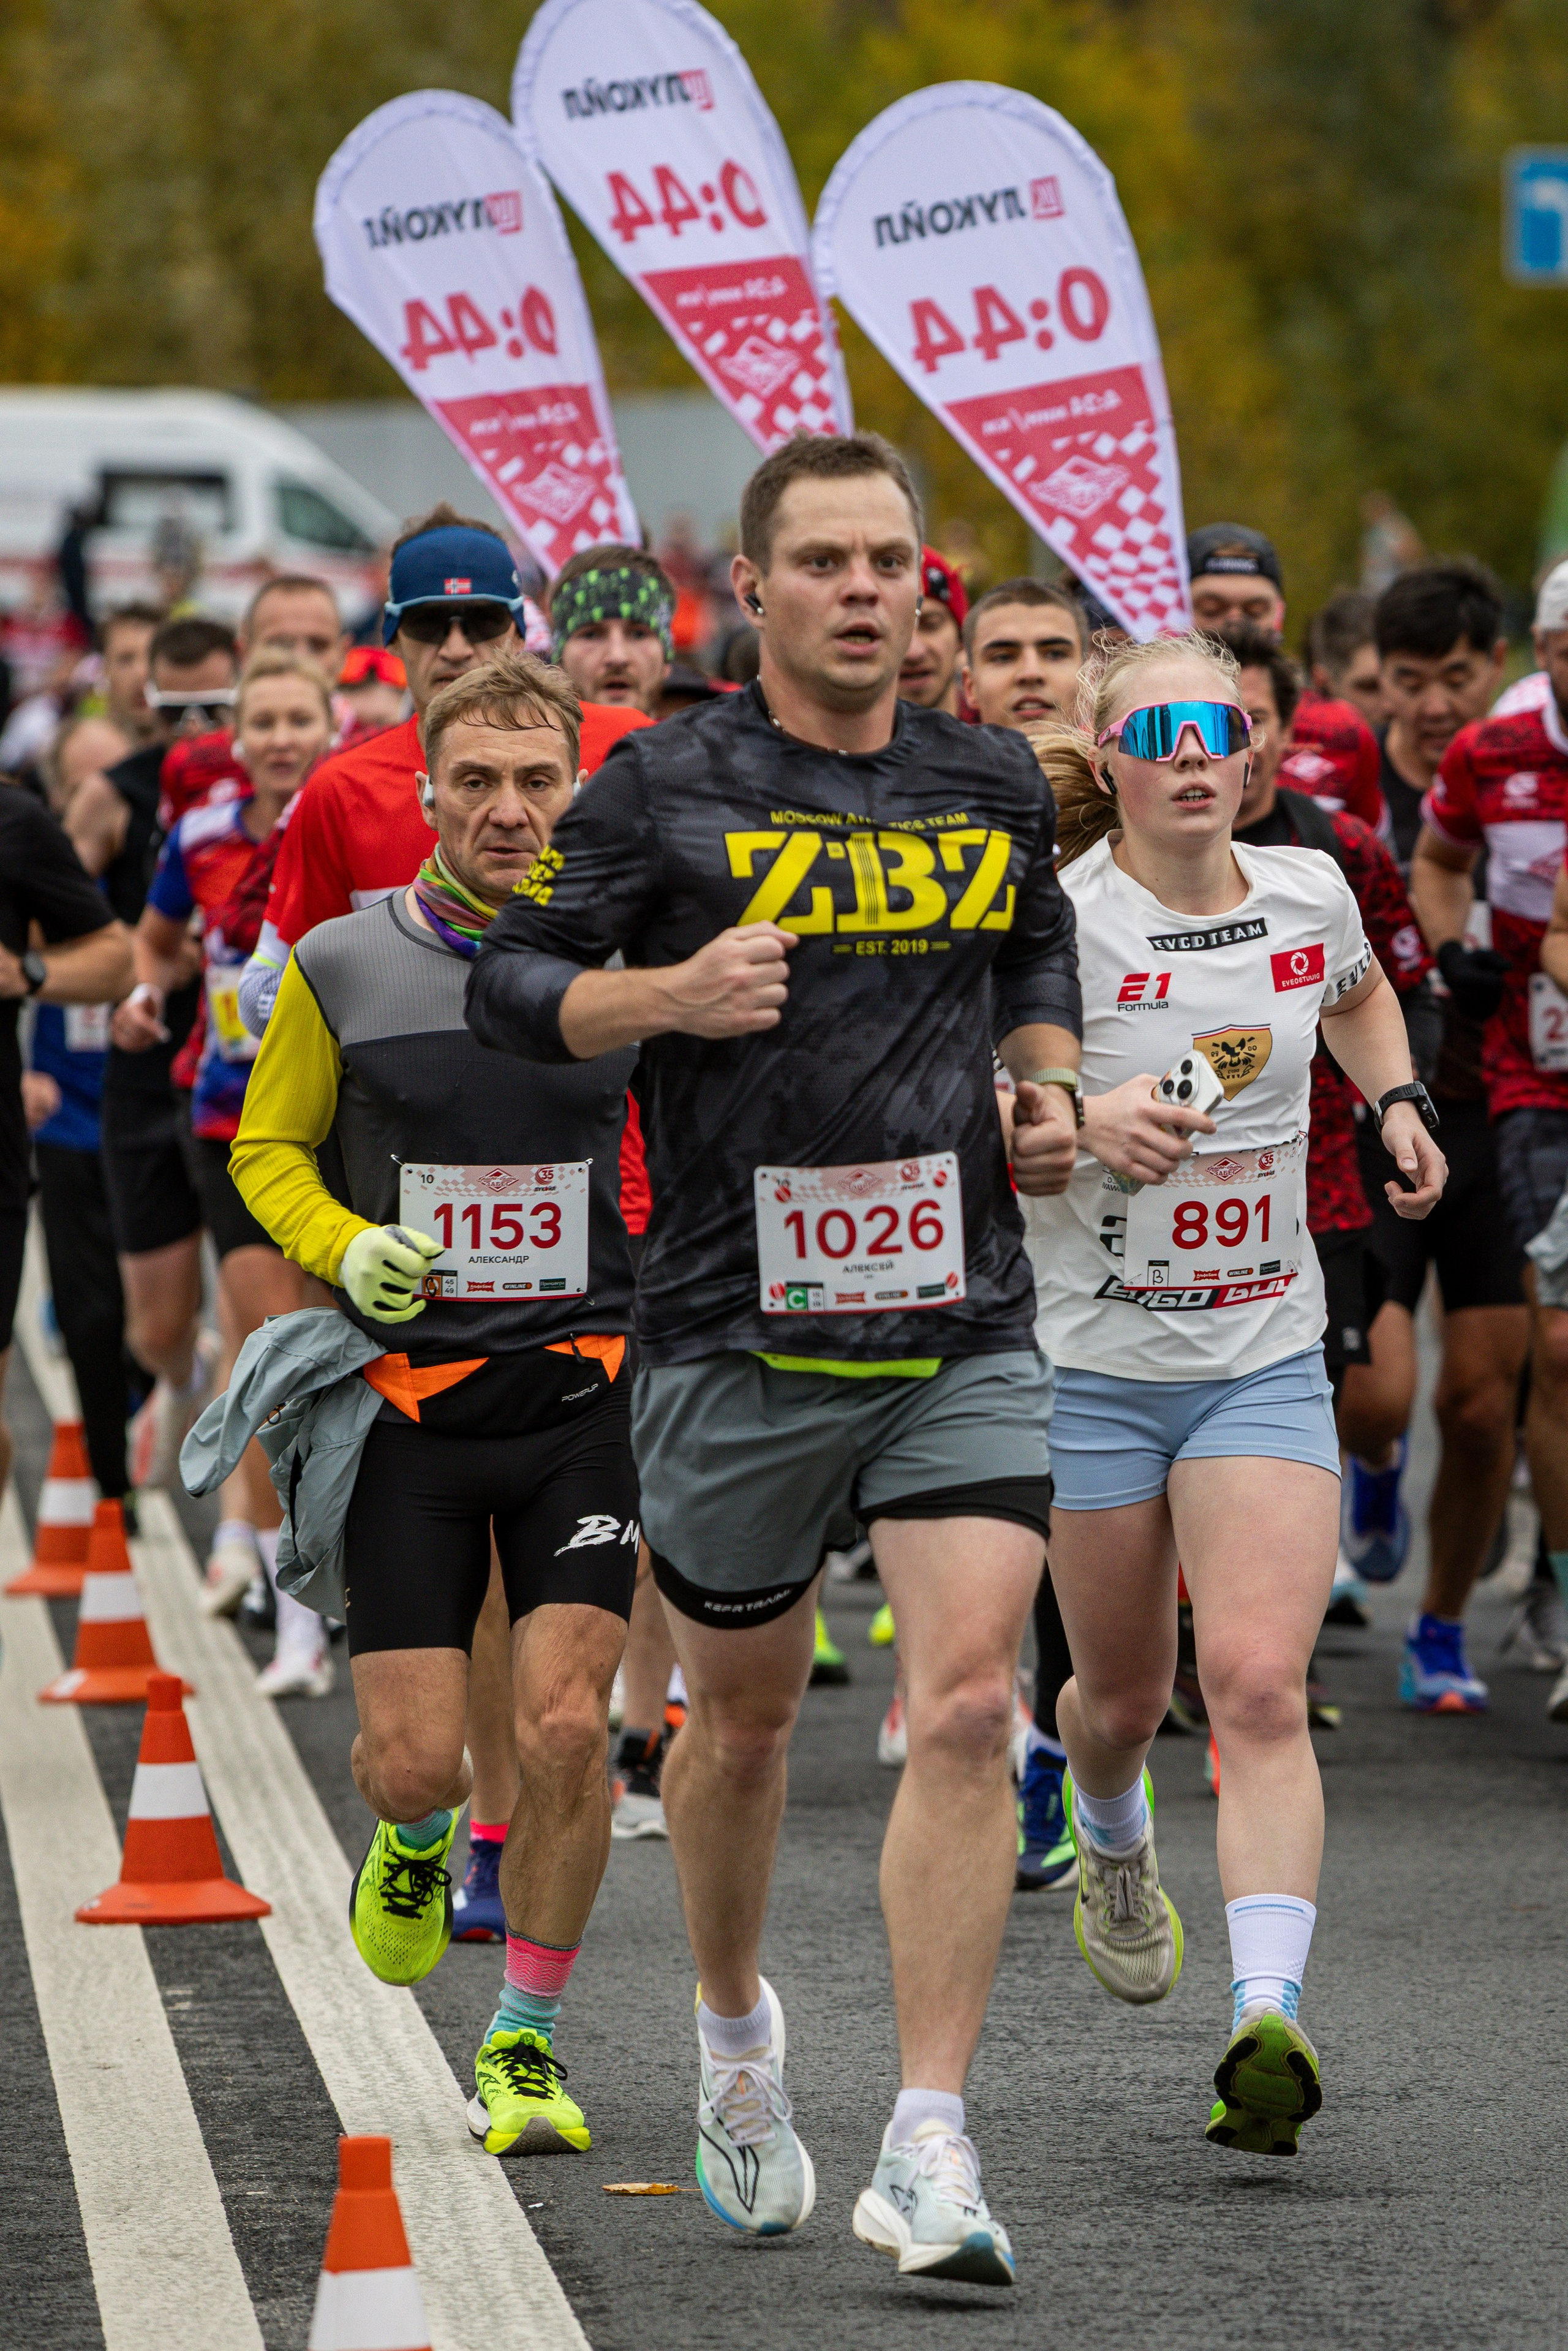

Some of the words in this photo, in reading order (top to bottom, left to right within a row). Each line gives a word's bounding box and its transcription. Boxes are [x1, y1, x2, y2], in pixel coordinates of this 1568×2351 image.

[925, 812, 970, 827] TEAM
[725, 829, 1016, 935] ZBZ
[1209, 923, 1263, 946] TEAM
[891, 939, 929, 955] 2019
[1117, 972, 1172, 1002] E1
[1117, 1001, 1169, 1012] Formula
[1264, 1155, 1274, 1164] 35
[421, 1174, 434, 1184] 10
[541, 1170, 554, 1179] 35
[434, 1201, 562, 1250] 1153
[784, 1198, 944, 1260] 1026
[1172, 1194, 1271, 1250] 891
[469, 1256, 530, 1264] АЛЕКСАНДР
[842, 1260, 895, 1274] АЛЕКСЕЙ
[788, 1291, 804, 1308] C
[562, 1383, 598, 1402] POWERUP
